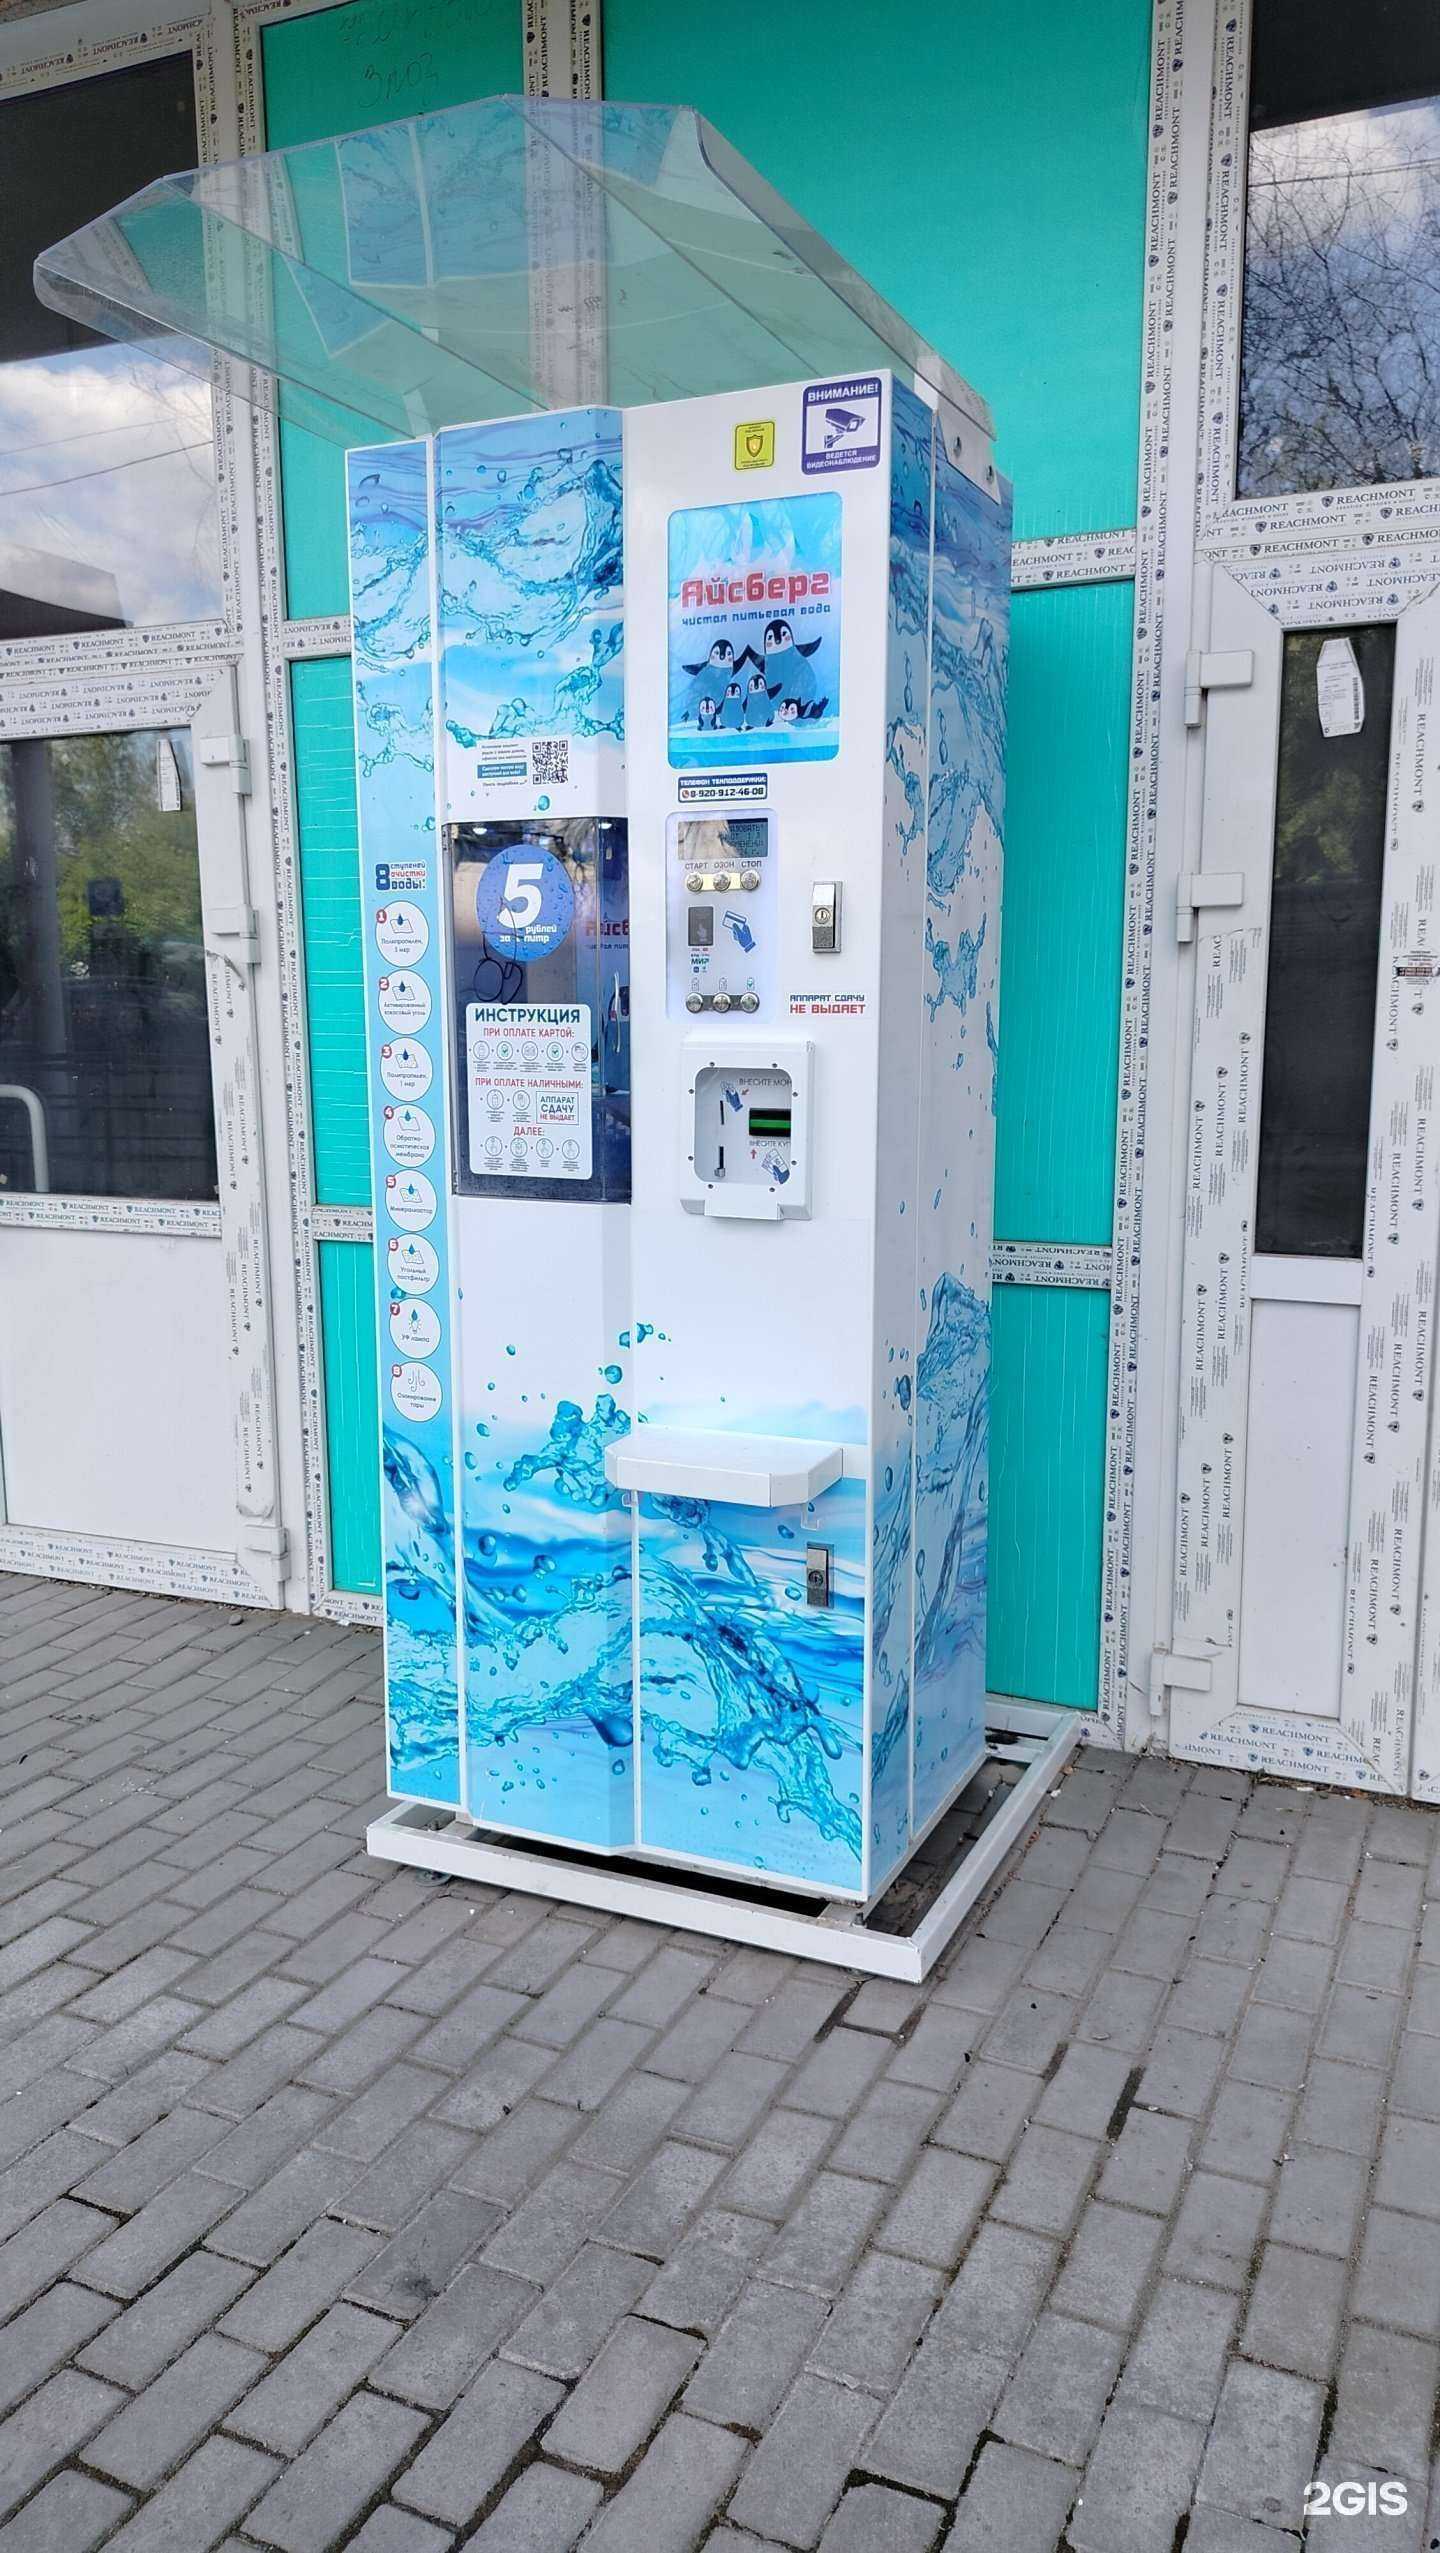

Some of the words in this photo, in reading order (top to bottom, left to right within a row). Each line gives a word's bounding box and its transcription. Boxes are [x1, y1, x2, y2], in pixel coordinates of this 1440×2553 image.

[1156, 40, 1165, 120] REACHMONT
[1171, 107, 1181, 188] REACHMONT
[1151, 173, 1161, 251] REACHMONT
[1219, 171, 1229, 250] REACHMONT
[1166, 238, 1175, 316] REACHMONT
[1147, 303, 1156, 377] REACHMONT
[1216, 301, 1225, 379] REACHMONT
[808, 384, 879, 402] ВНИМАНИЕ!
[1161, 367, 1171, 443] REACHMONT
[807, 455, 877, 469] ВИДЕОНАБЛЮДЕНИЕ
[825, 450, 857, 460] ВЕДЕТСЯ
[1211, 429, 1220, 503] REACHMONT
[1270, 515, 1347, 530] REACHMONT
[1337, 489, 1416, 504] REACHMONT
[682, 572, 829, 608] Айсберг
[1056, 565, 1126, 579] REACHMONT
[1139, 552, 1148, 624] REACHMONT
[1311, 560, 1385, 574] REACHMONT
[682, 615, 727, 626] чистая
[732, 607, 795, 622] питьевая
[800, 603, 831, 616] вода
[1309, 596, 1383, 610] REACHMONT
[1153, 614, 1163, 687] REACHMONT
[1136, 671, 1145, 744] REACHMONT
[1149, 733, 1160, 805] REACHMONT
[1414, 713, 1426, 794] REACHMONT
[690, 788, 764, 798] 8-920-912-46-08
[1130, 789, 1140, 860] REACHMONT
[375, 863, 390, 890] 8
[497, 863, 543, 929] 5
[685, 862, 708, 870] СТАРТ
[741, 860, 762, 868] СТОП
[523, 935, 550, 944] литр
[525, 925, 557, 934] рублей
[1127, 905, 1136, 975] REACHMONT
[381, 979, 388, 990] 2
[790, 994, 830, 1002] АППАРАТ
[834, 994, 864, 1002] СДАЧУ
[790, 1004, 807, 1014] НЕ
[811, 1004, 866, 1014] ВЫДАЕТ
[1141, 966, 1150, 1041] REACHMONT
[475, 1008, 580, 1025] ИНСТРУКЦИЯ
[484, 1028, 500, 1037] ПРИ
[504, 1028, 536, 1037] ОПЛАТЕ
[538, 1028, 575, 1038] КАРТОЙ:
[475, 1078, 491, 1086] ПРИ
[494, 1078, 525, 1087] ОПЛАТЕ
[528, 1079, 583, 1089] НАЛИЧНЫМИ:
[1123, 1018, 1133, 1086] REACHMONT
[386, 1107, 393, 1118] 4
[540, 1096, 575, 1104] АППАРАТ
[541, 1104, 574, 1113] СДАЧУ
[1137, 1079, 1146, 1144] REACHMONT
[1238, 1048, 1249, 1123] REACHMONT
[513, 1127, 545, 1137] ДАЛЕЕ:
[1215, 1082, 1226, 1157] REACHMONT
[387, 1176, 395, 1188] 5
[1414, 1118, 1426, 1194] REACHMONT
[1132, 1189, 1142, 1255] REACHMONT
[1391, 1153, 1401, 1228] REACHMONT
[1035, 1275, 1099, 1287] REACHMONT
[1116, 1239, 1124, 1301] REACHMONT
[392, 1304, 399, 1315] 7
[1129, 1295, 1139, 1359] REACHMONT
[1218, 1268, 1228, 1340] REACHMONT
[1196, 1301, 1206, 1371] REACHMONT
[1415, 1312, 1427, 1390] REACHMONT
[1112, 1343, 1121, 1406] REACHMONT
[1366, 1376, 1377, 1448] REACHMONT
[1109, 1447, 1118, 1509] REACHMONT
[1223, 1448, 1233, 1518] REACHMONT
[1121, 1504, 1131, 1566] REACHMONT
[1201, 1477, 1211, 1548] REACHMONT
[1105, 1550, 1114, 1613] REACHMONT
[1369, 1559, 1378, 1629] REACHMONT
[1391, 1529, 1402, 1599] REACHMONT
[1118, 1605, 1128, 1667] REACHMONT
[1102, 1649, 1111, 1713] REACHMONT
[1210, 1734, 1277, 1750] REACHMONT
[1261, 1756, 1329, 1774] REACHMONT
